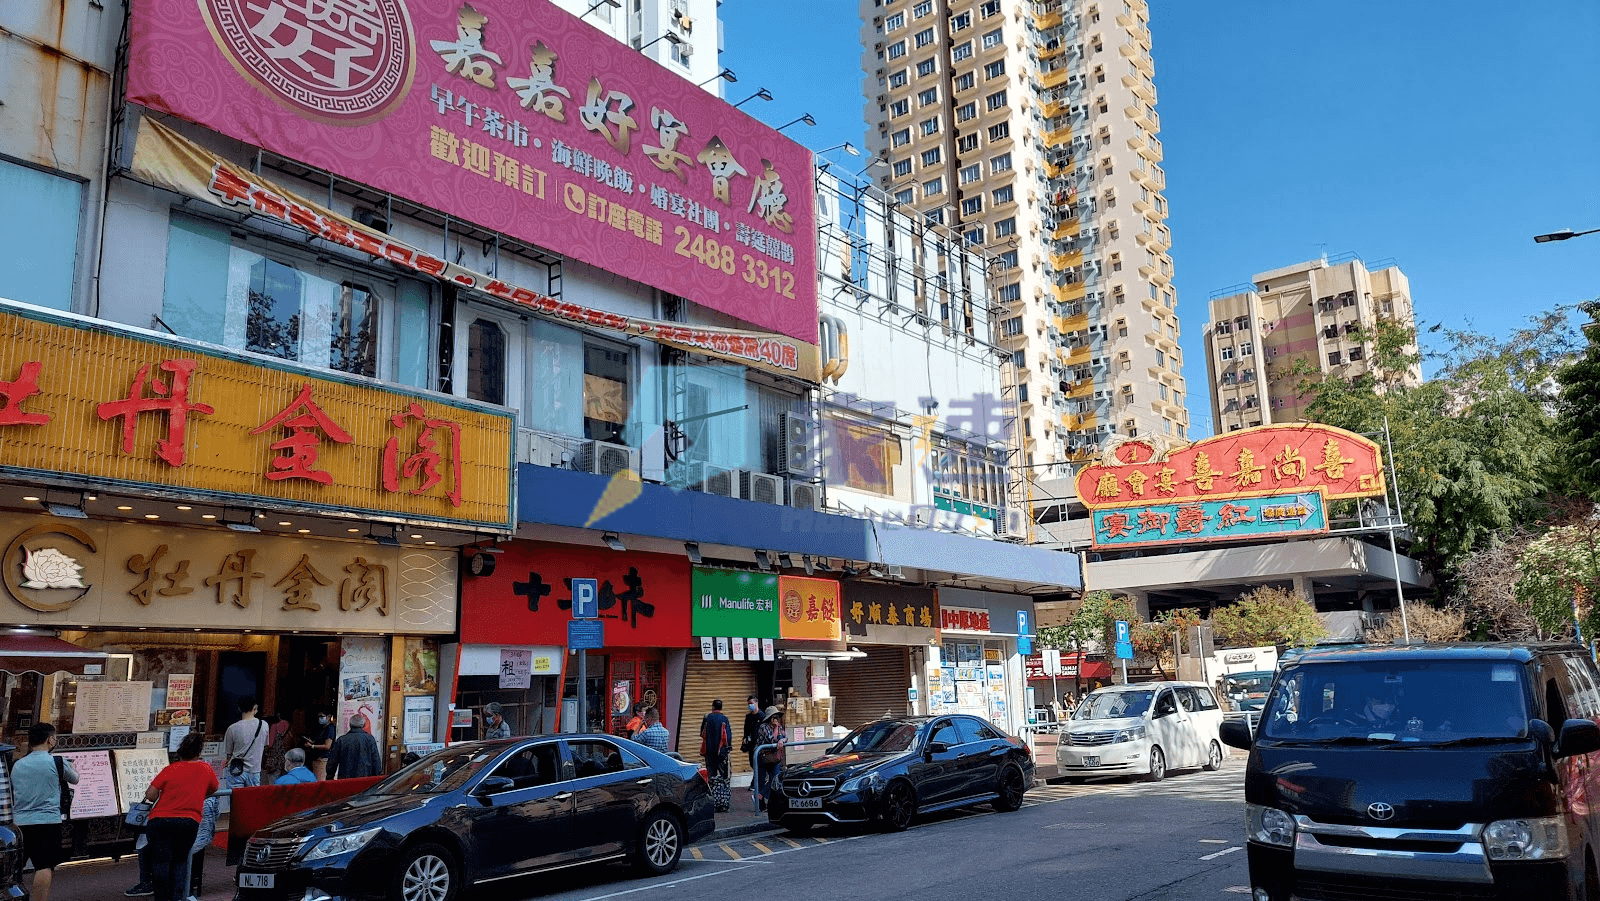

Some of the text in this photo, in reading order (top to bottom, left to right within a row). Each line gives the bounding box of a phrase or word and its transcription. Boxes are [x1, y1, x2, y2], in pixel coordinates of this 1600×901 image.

[429, 2, 795, 234] 嘉嘉好宴會廳
[430, 124, 548, 201] 歡迎預訂
[587, 191, 796, 300] 訂座電話 2488 3312
[125, 544, 392, 617] 牡丹金閣
[578, 583, 594, 615] P
[719, 596, 773, 612] Manulife 宏利
[1019, 613, 1026, 633] P
[1118, 623, 1127, 641] P
[244, 874, 269, 887] NL 718
